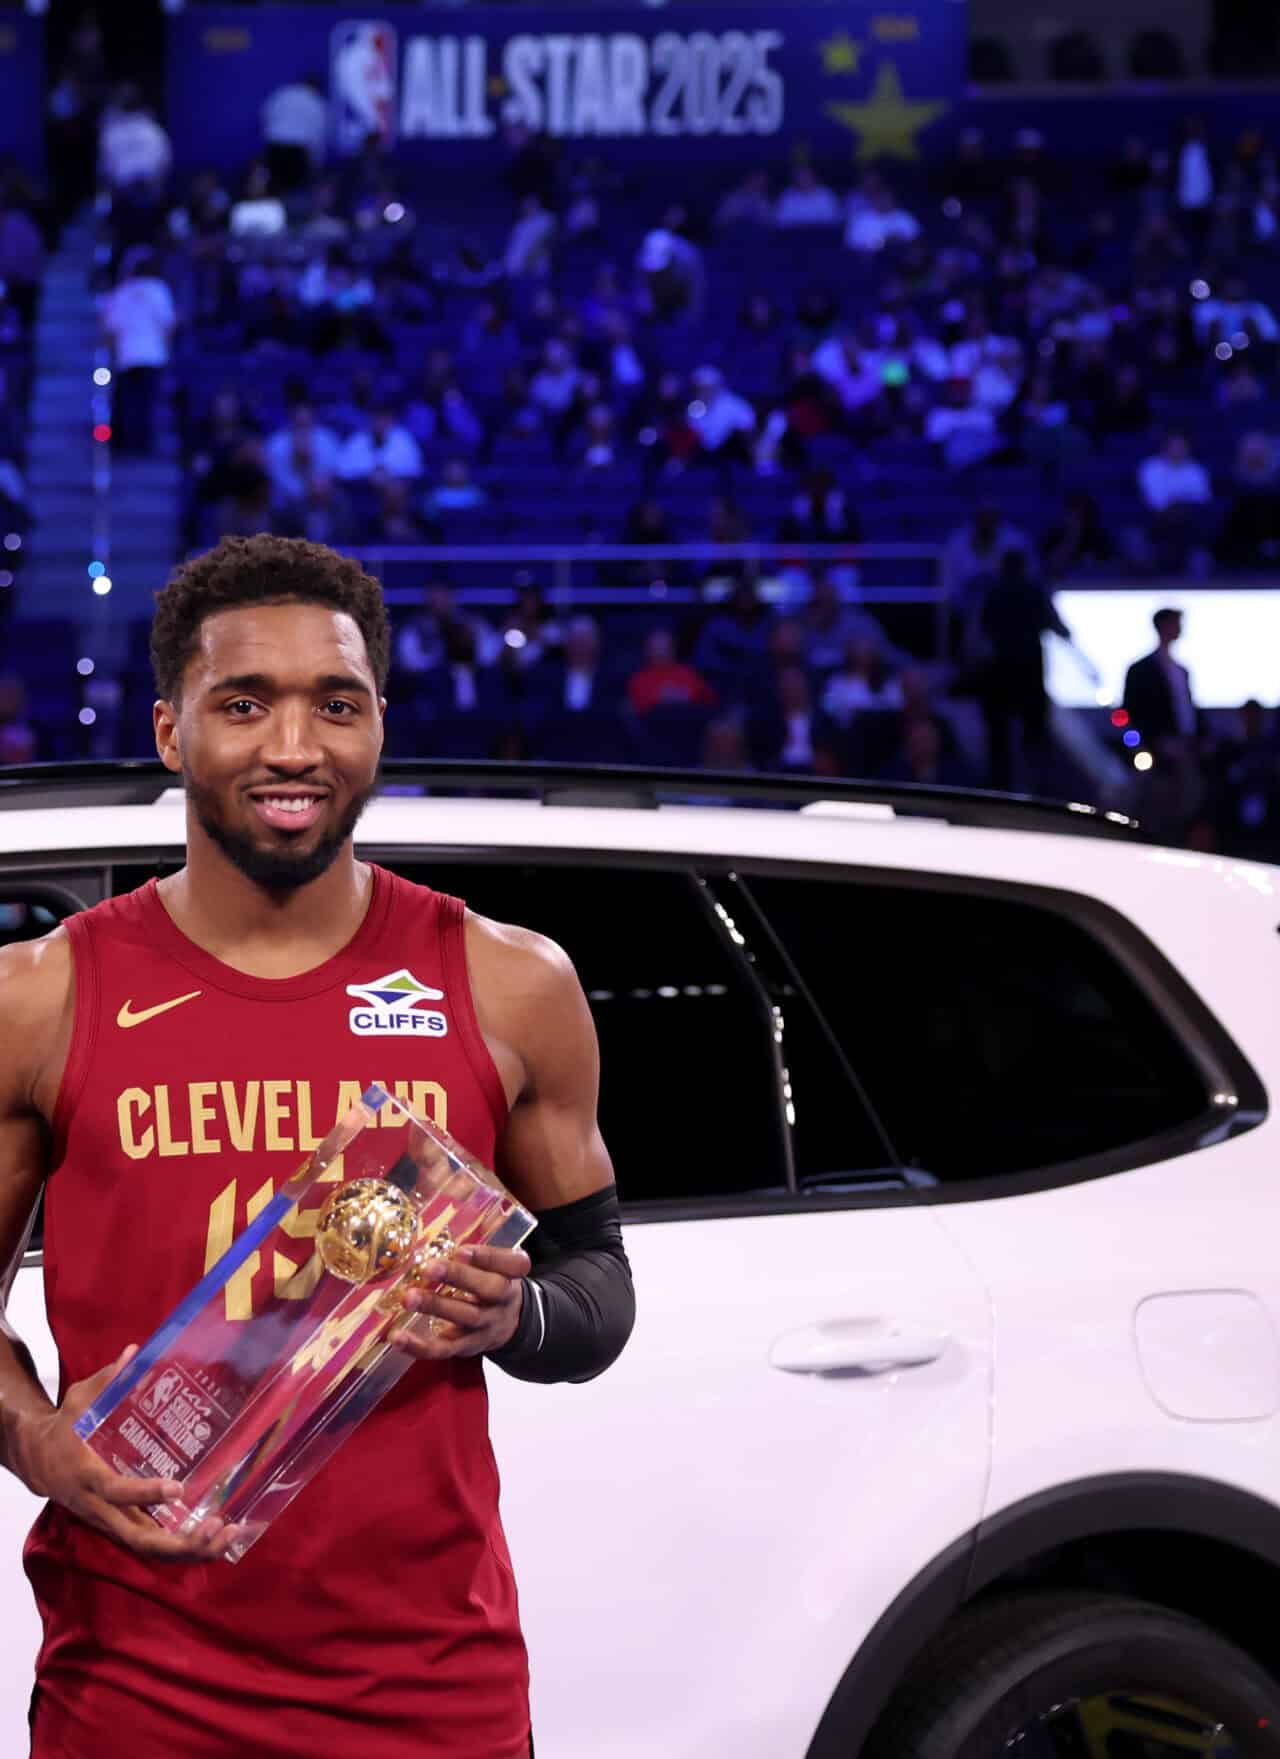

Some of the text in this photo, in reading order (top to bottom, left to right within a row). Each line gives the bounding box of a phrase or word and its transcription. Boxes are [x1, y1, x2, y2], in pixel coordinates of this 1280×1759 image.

[401, 30, 783, 138] ALL STAR 2025
[353, 1013, 444, 1032] CLIFFS
[118, 1415, 180, 1480] CHAMPIONS
